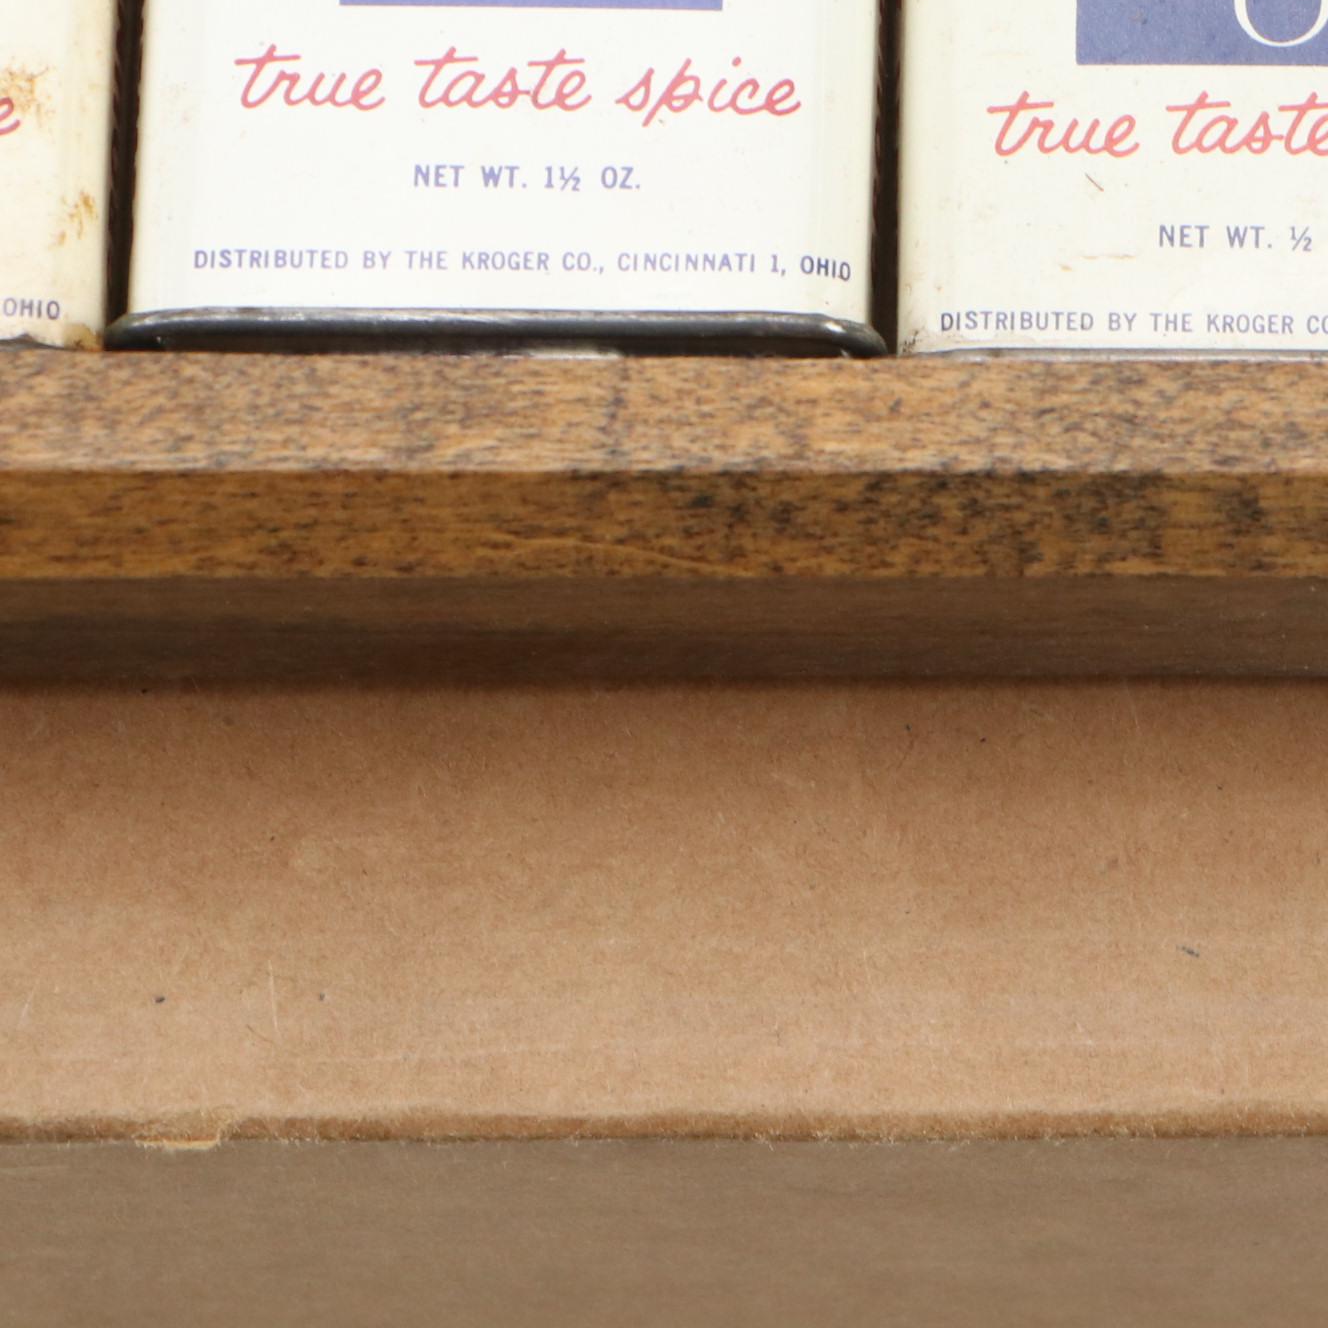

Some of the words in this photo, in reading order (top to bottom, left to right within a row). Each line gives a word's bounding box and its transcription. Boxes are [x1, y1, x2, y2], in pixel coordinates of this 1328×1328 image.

[234, 44, 385, 112] true
[414, 47, 592, 112] taste
[615, 57, 801, 127] spice
[987, 91, 1140, 158] true
[414, 165, 464, 187] NET
[481, 166, 526, 188] WT.
[601, 166, 640, 189] OZ.
[1159, 225, 1209, 248] NET
[1227, 226, 1272, 248] WT.
[194, 249, 348, 269] DISTRIBUTED
[363, 251, 391, 269] BY
[406, 251, 447, 270] THE
[462, 252, 549, 271] KROGER
[562, 252, 604, 274] CO.,
[618, 253, 755, 272] CINCINNATI
[771, 254, 786, 276] 1,
[801, 256, 850, 282] OHIO
[4, 299, 60, 320] OHIO
[940, 311, 1093, 333] DISTRIBUTED
[1109, 312, 1136, 331] BY
[1150, 313, 1192, 332] THE
[1207, 314, 1294, 335] KROGER
